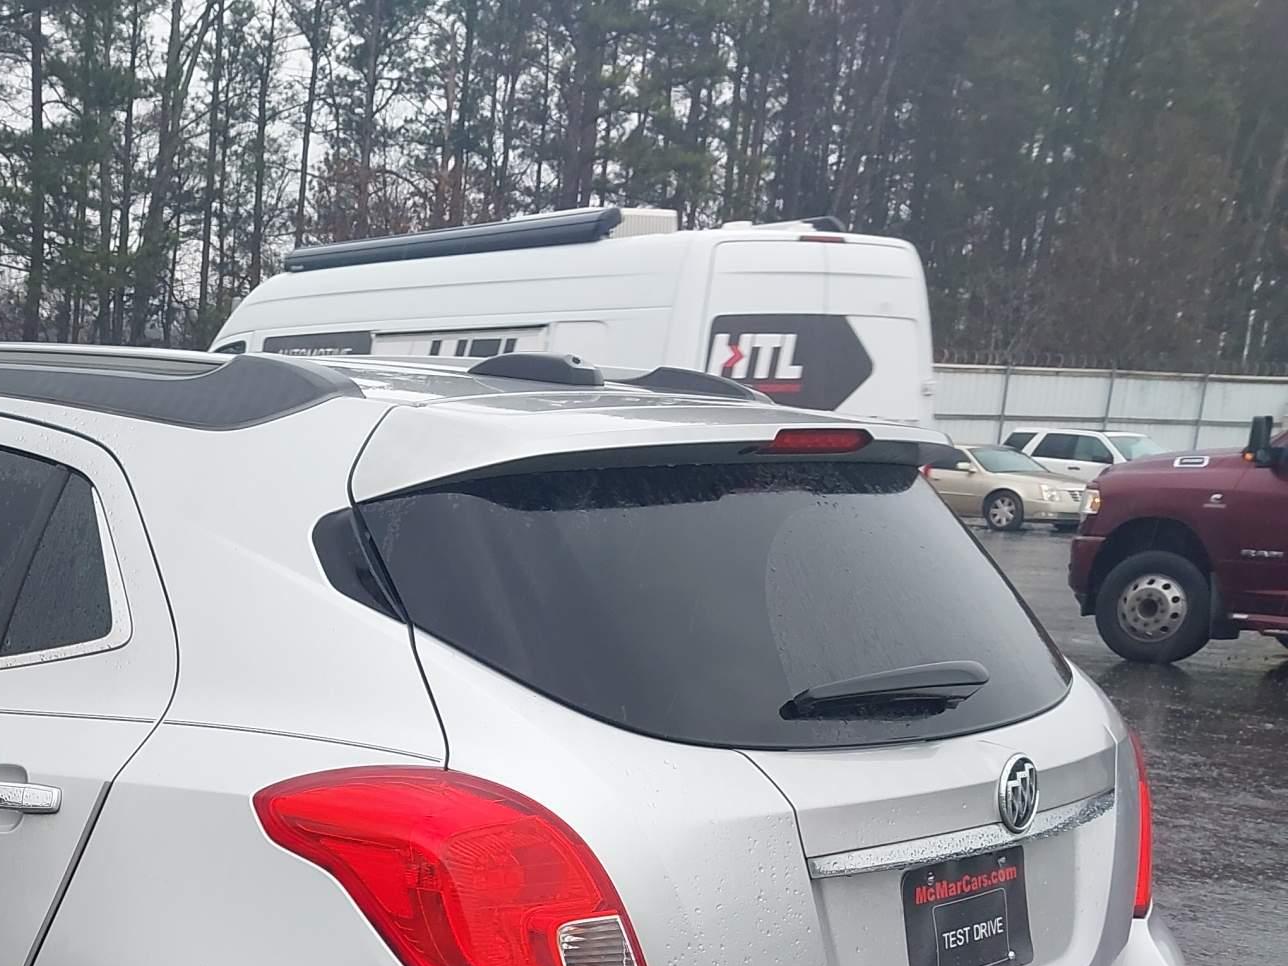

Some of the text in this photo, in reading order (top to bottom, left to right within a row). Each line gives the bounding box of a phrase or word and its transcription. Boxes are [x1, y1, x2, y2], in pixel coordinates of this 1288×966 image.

[915, 865, 1018, 905] McMarCars.com
[942, 916, 1005, 950] TEST DRIVE
